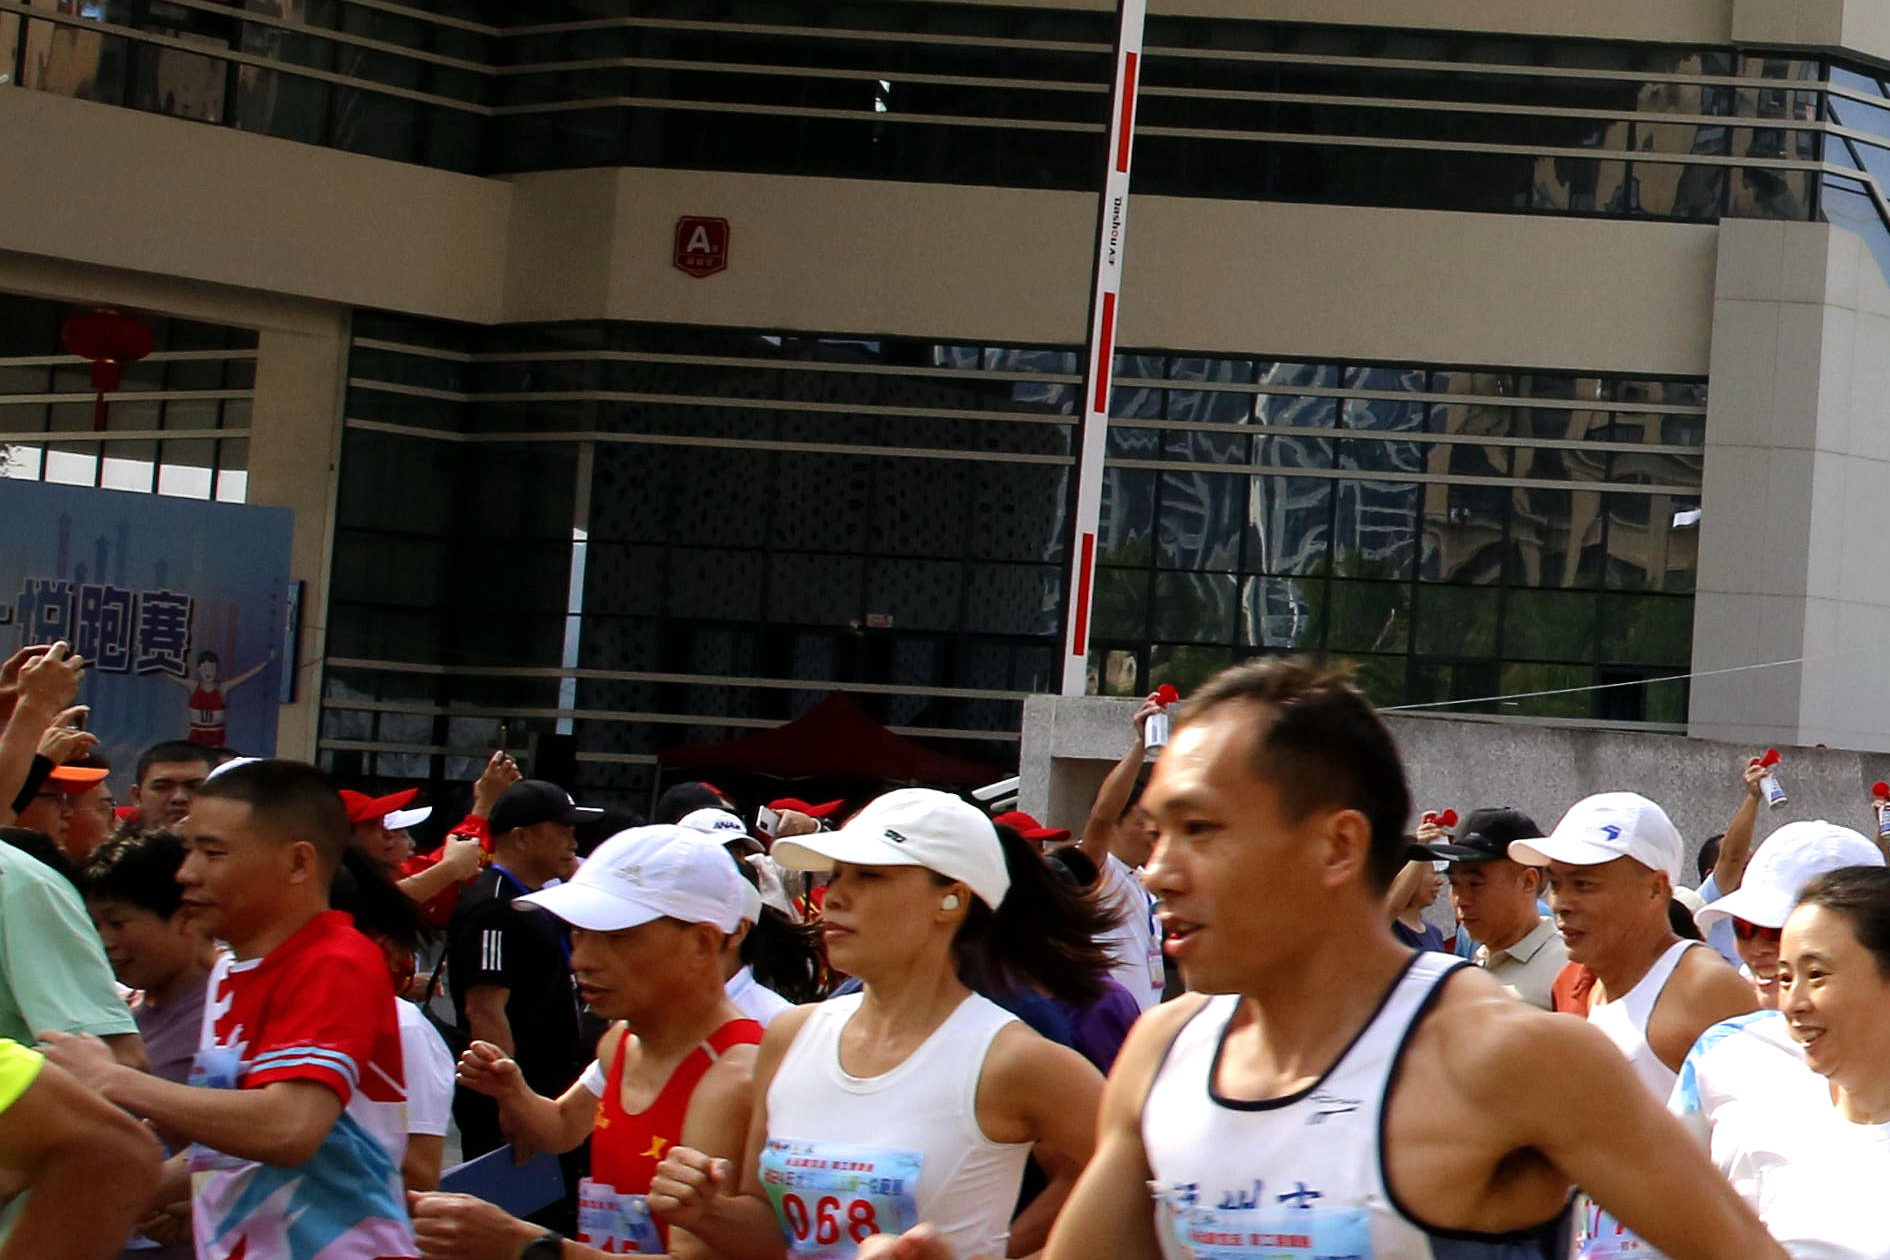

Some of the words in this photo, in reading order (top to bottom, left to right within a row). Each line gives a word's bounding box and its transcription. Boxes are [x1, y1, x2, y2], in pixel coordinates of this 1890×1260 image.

[686, 225, 711, 253] A
[0, 576, 192, 677] 悦跑赛
[781, 1193, 881, 1245] 068
